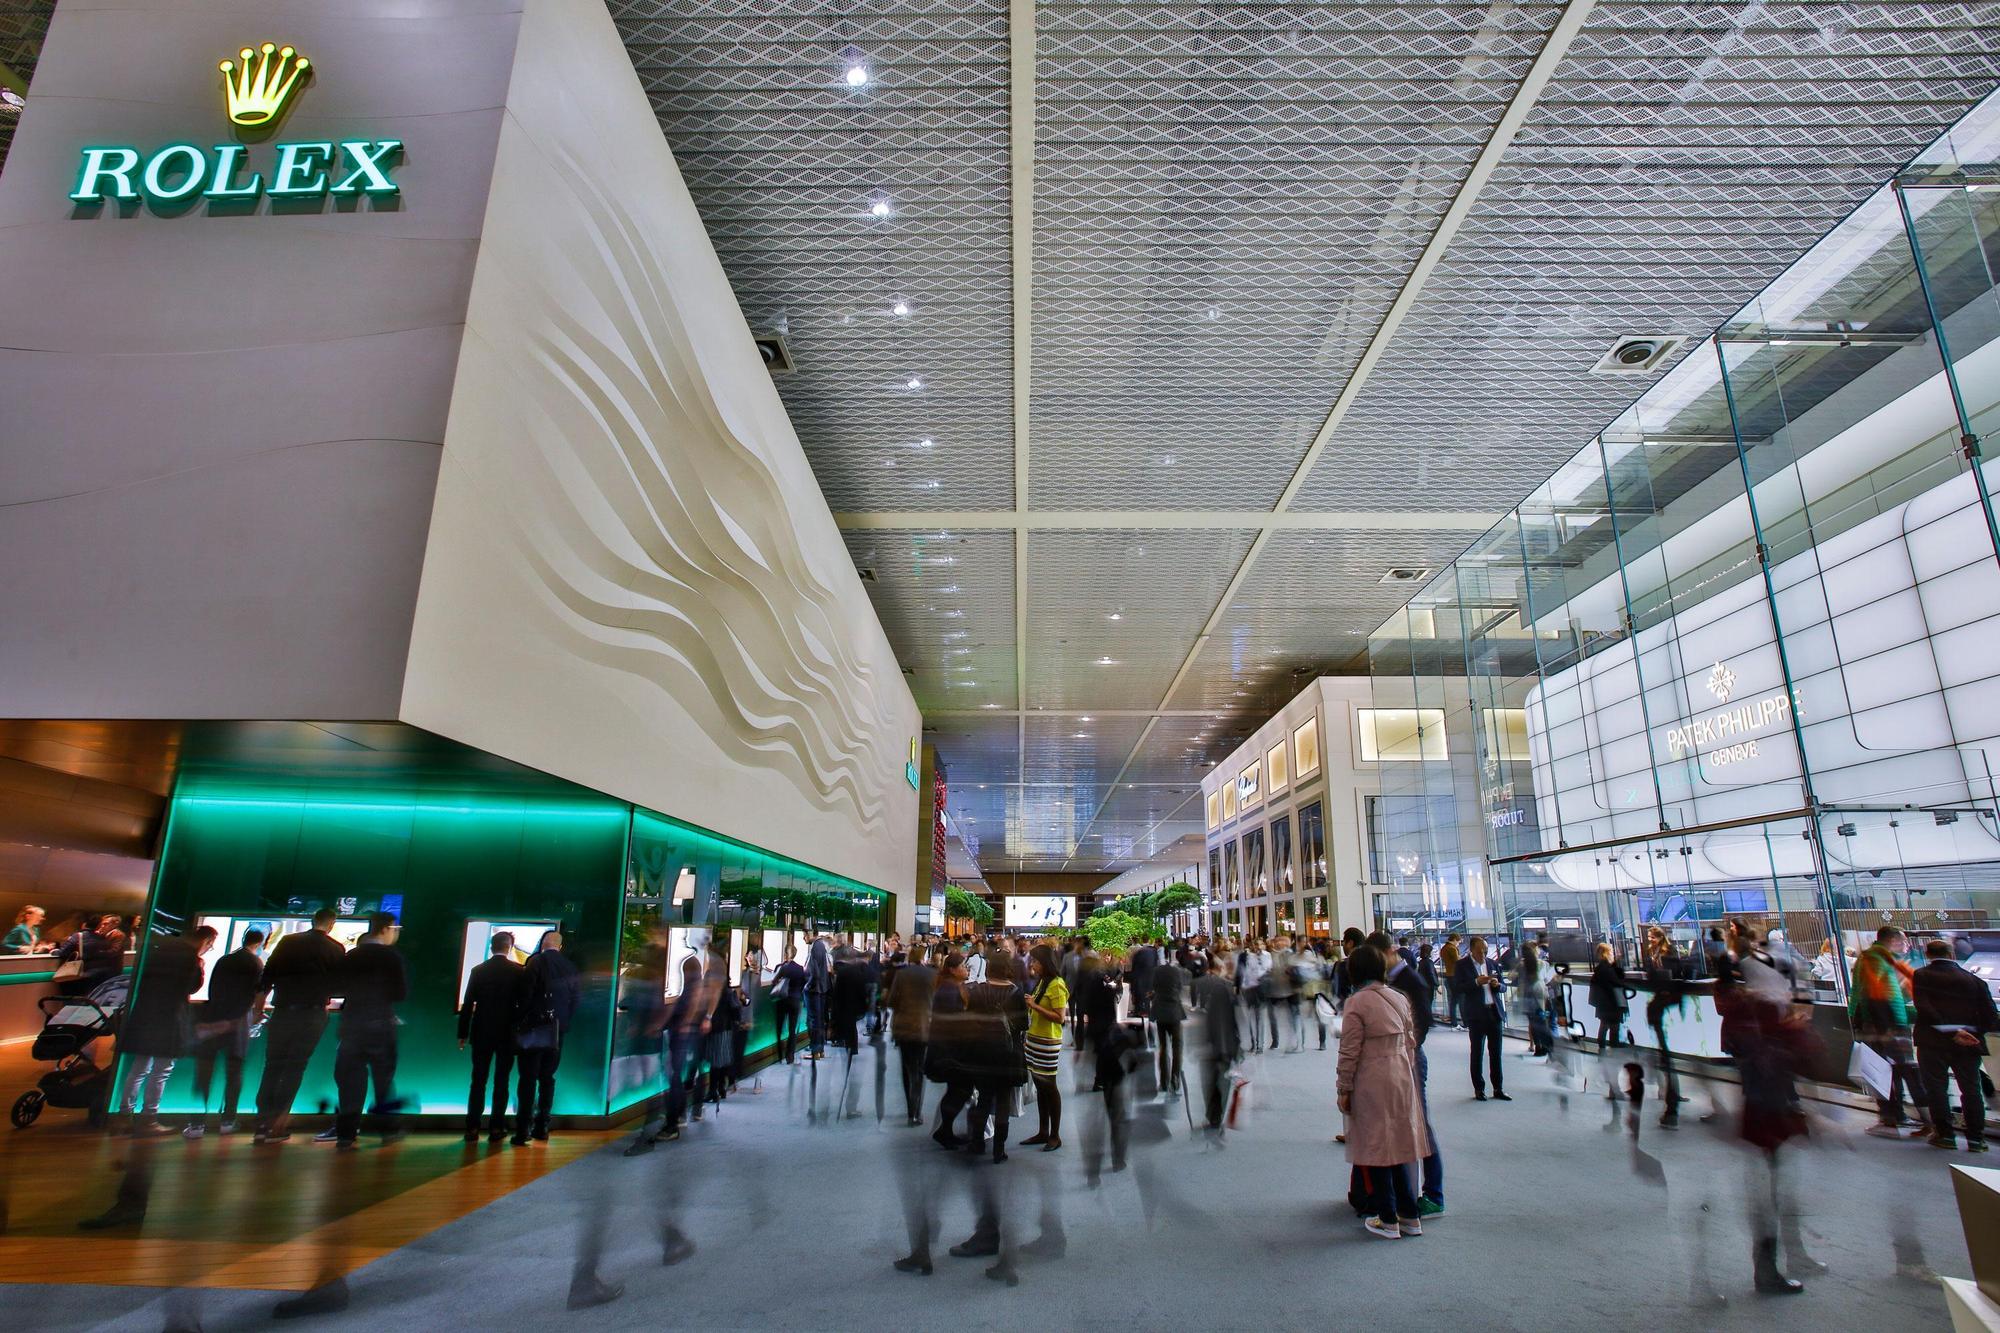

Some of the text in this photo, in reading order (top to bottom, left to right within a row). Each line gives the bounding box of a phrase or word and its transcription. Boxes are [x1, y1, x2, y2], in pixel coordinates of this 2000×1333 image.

[69, 140, 403, 203] ROLEX
[1667, 718, 1717, 752] PATEK
[1710, 741, 1757, 767] GENEVE
